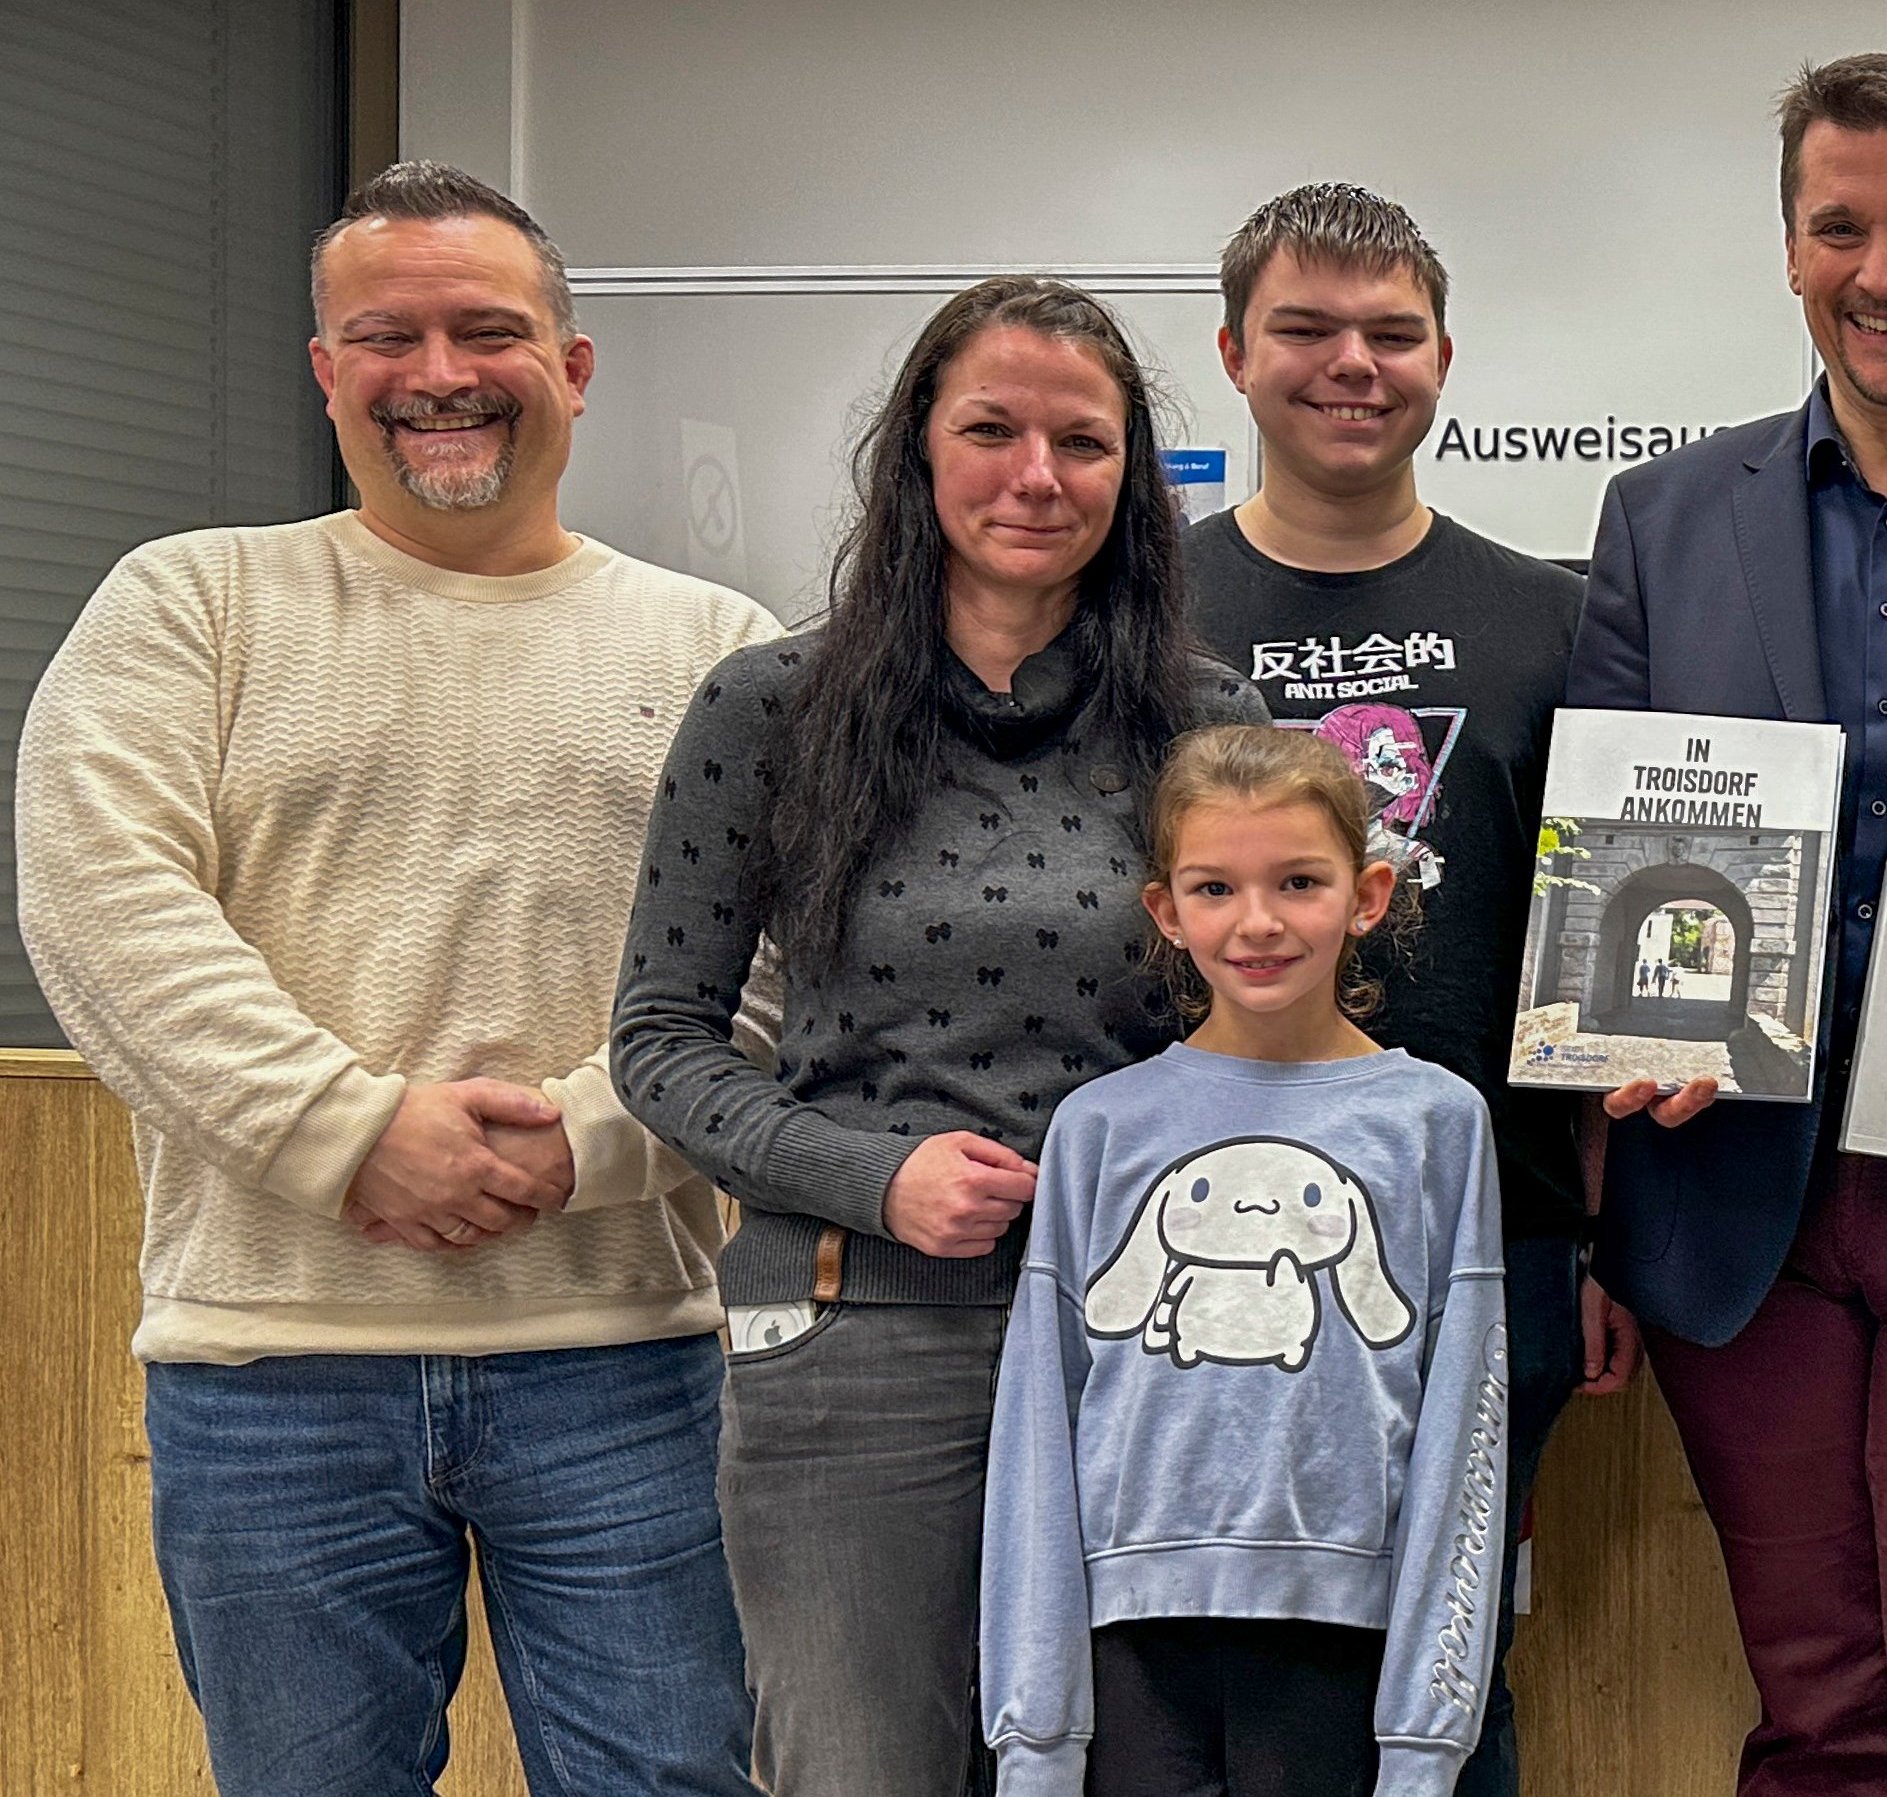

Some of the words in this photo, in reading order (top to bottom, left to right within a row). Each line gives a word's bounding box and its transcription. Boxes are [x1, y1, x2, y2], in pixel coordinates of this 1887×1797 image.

[1435, 416, 1729, 461] Ausweisa
[1251, 632, 1456, 680] 反社会的
[1284, 683, 1335, 699] ANTI
[1336, 674, 1419, 698] SOCIAL
[1686, 738, 1711, 763] IN
[1633, 765, 1759, 797] TROISDORF
[1619, 796, 1762, 828] ANKOMMEN
